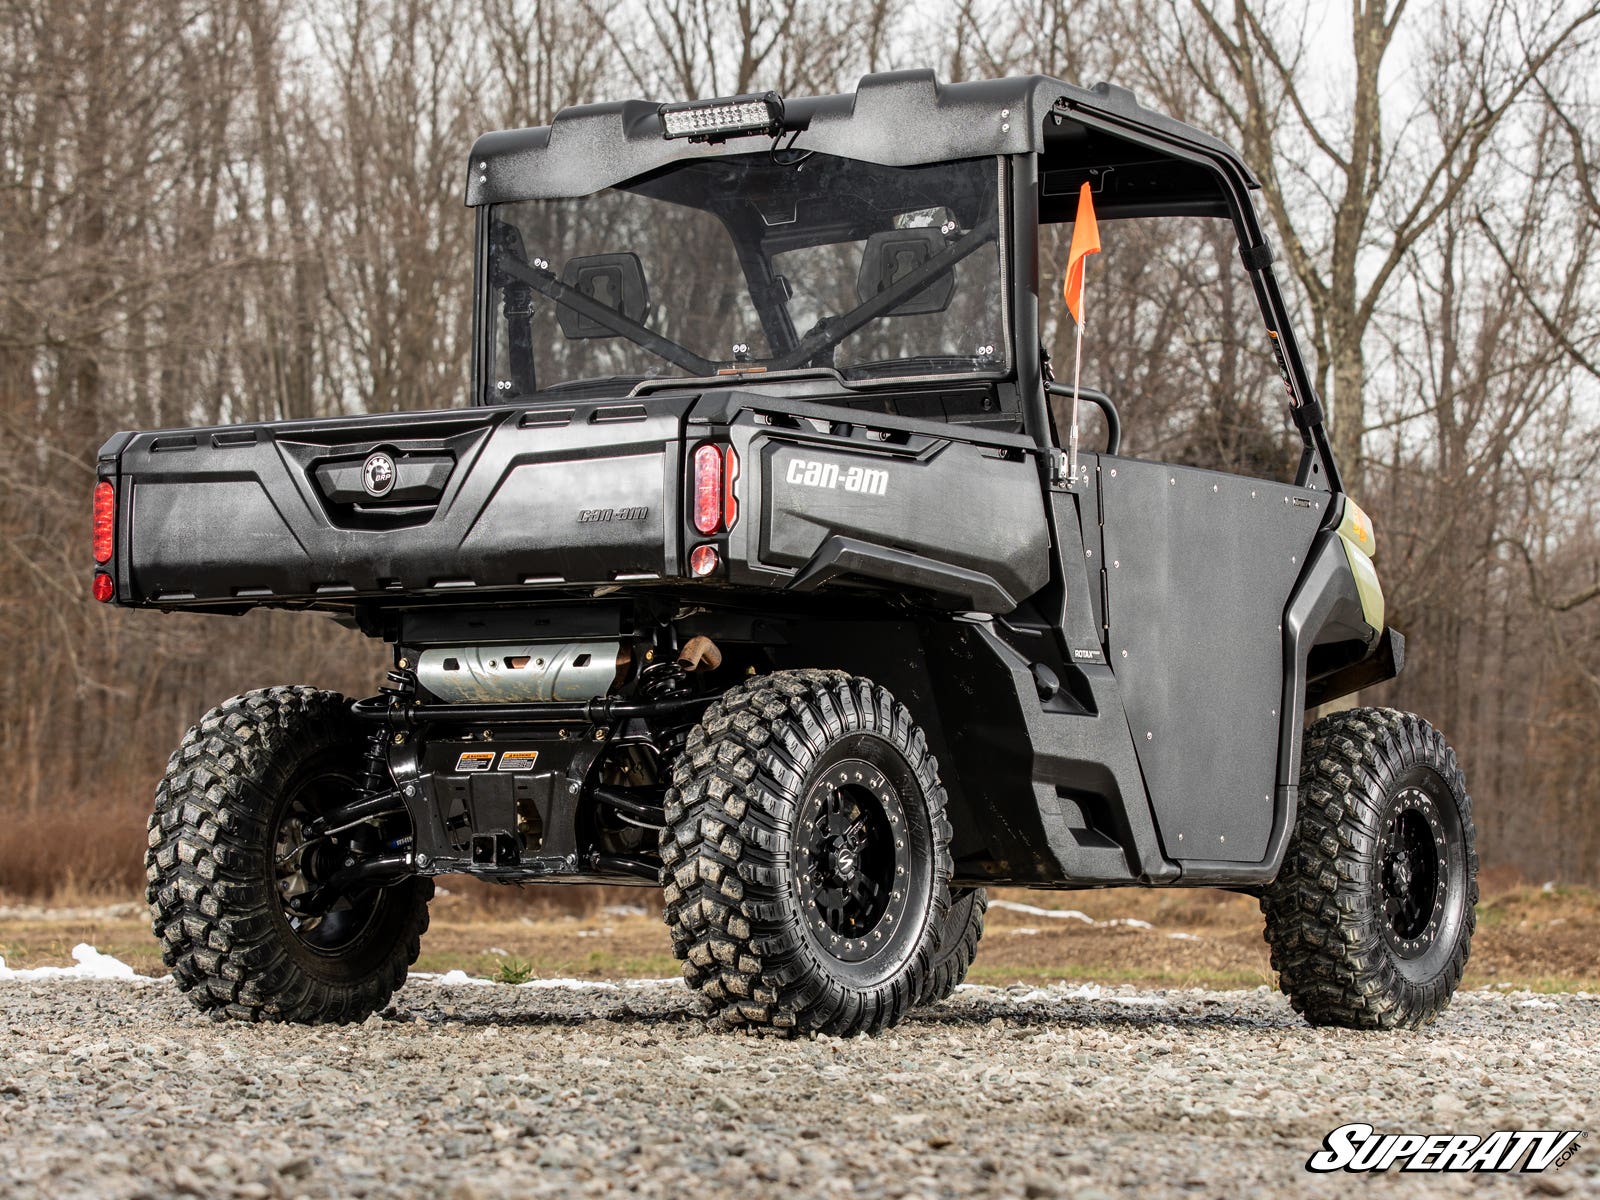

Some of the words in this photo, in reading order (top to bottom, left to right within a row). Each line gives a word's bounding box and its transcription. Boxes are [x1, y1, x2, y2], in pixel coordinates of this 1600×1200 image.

[375, 474, 392, 482] BRP
[786, 459, 889, 496] can-am
[577, 506, 648, 523] can-am
